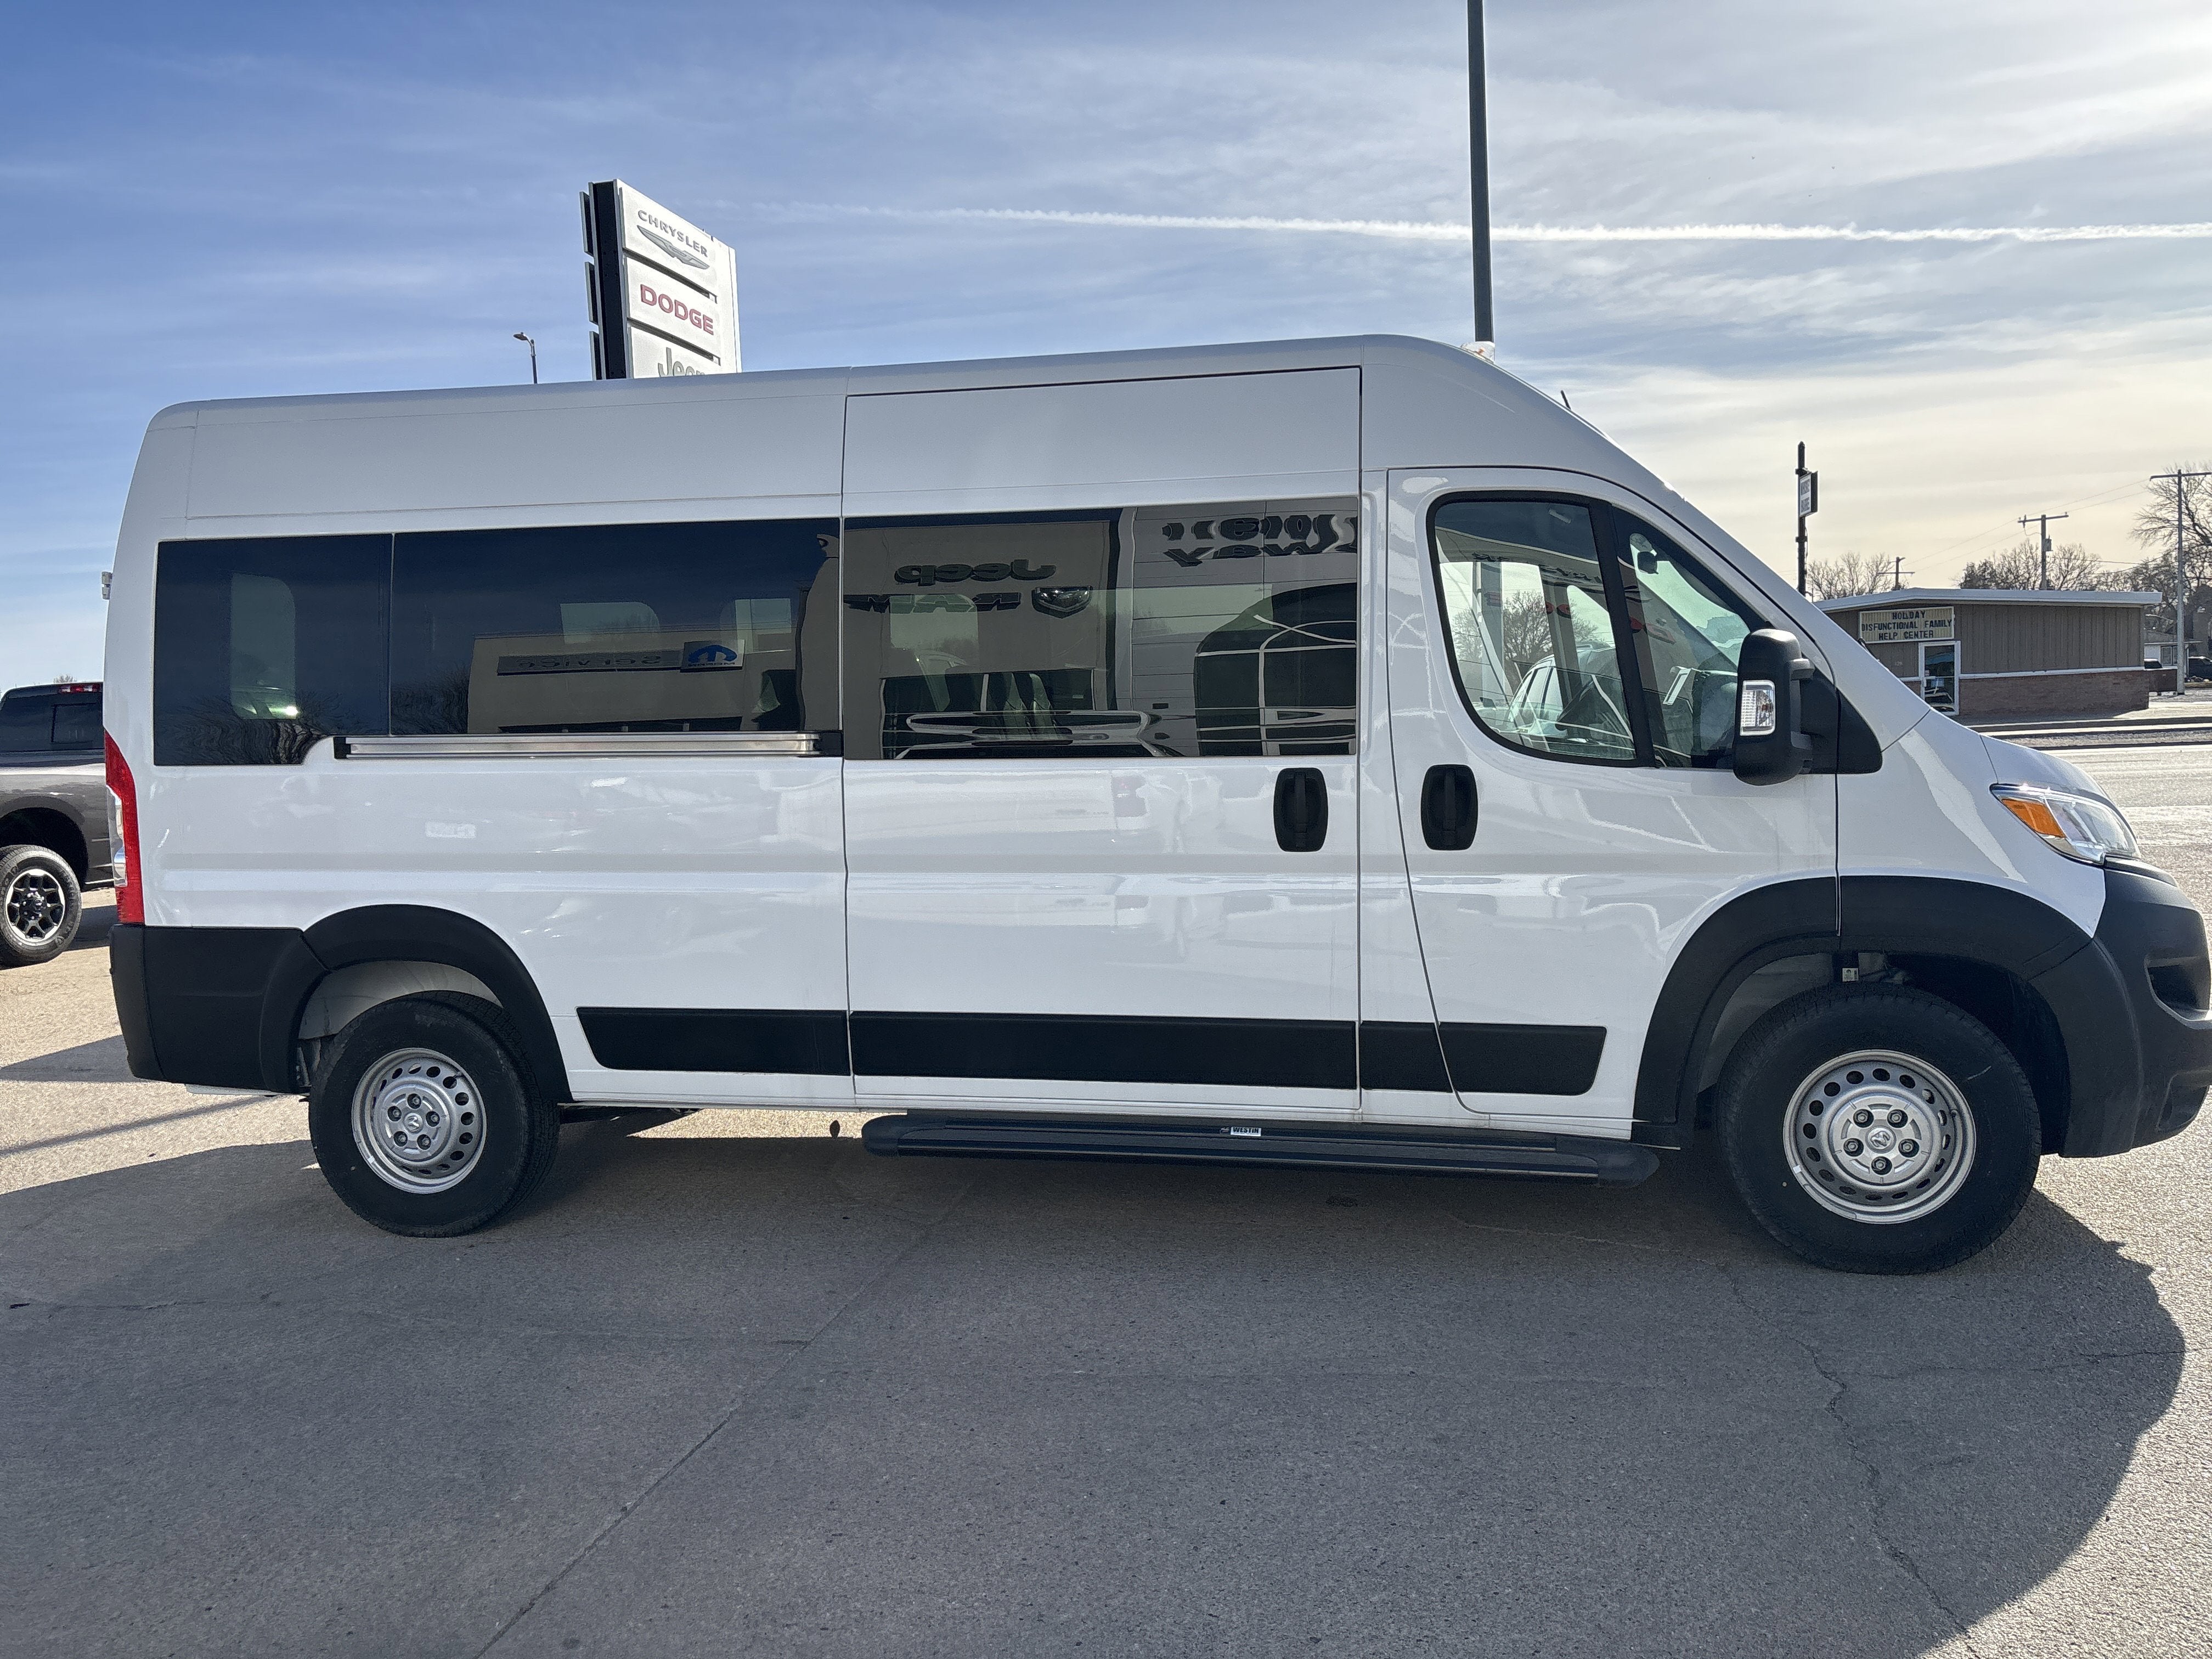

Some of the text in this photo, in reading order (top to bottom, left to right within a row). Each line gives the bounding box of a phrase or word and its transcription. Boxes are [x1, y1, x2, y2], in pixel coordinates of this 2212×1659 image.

[637, 210, 708, 257] CHRYSLER
[640, 284, 714, 335] DODGE
[657, 347, 704, 377] Je
[1861, 619, 1952, 631] DISFUNCTIONAL FAMILY
[1878, 630, 1934, 640] HELP CENTER
